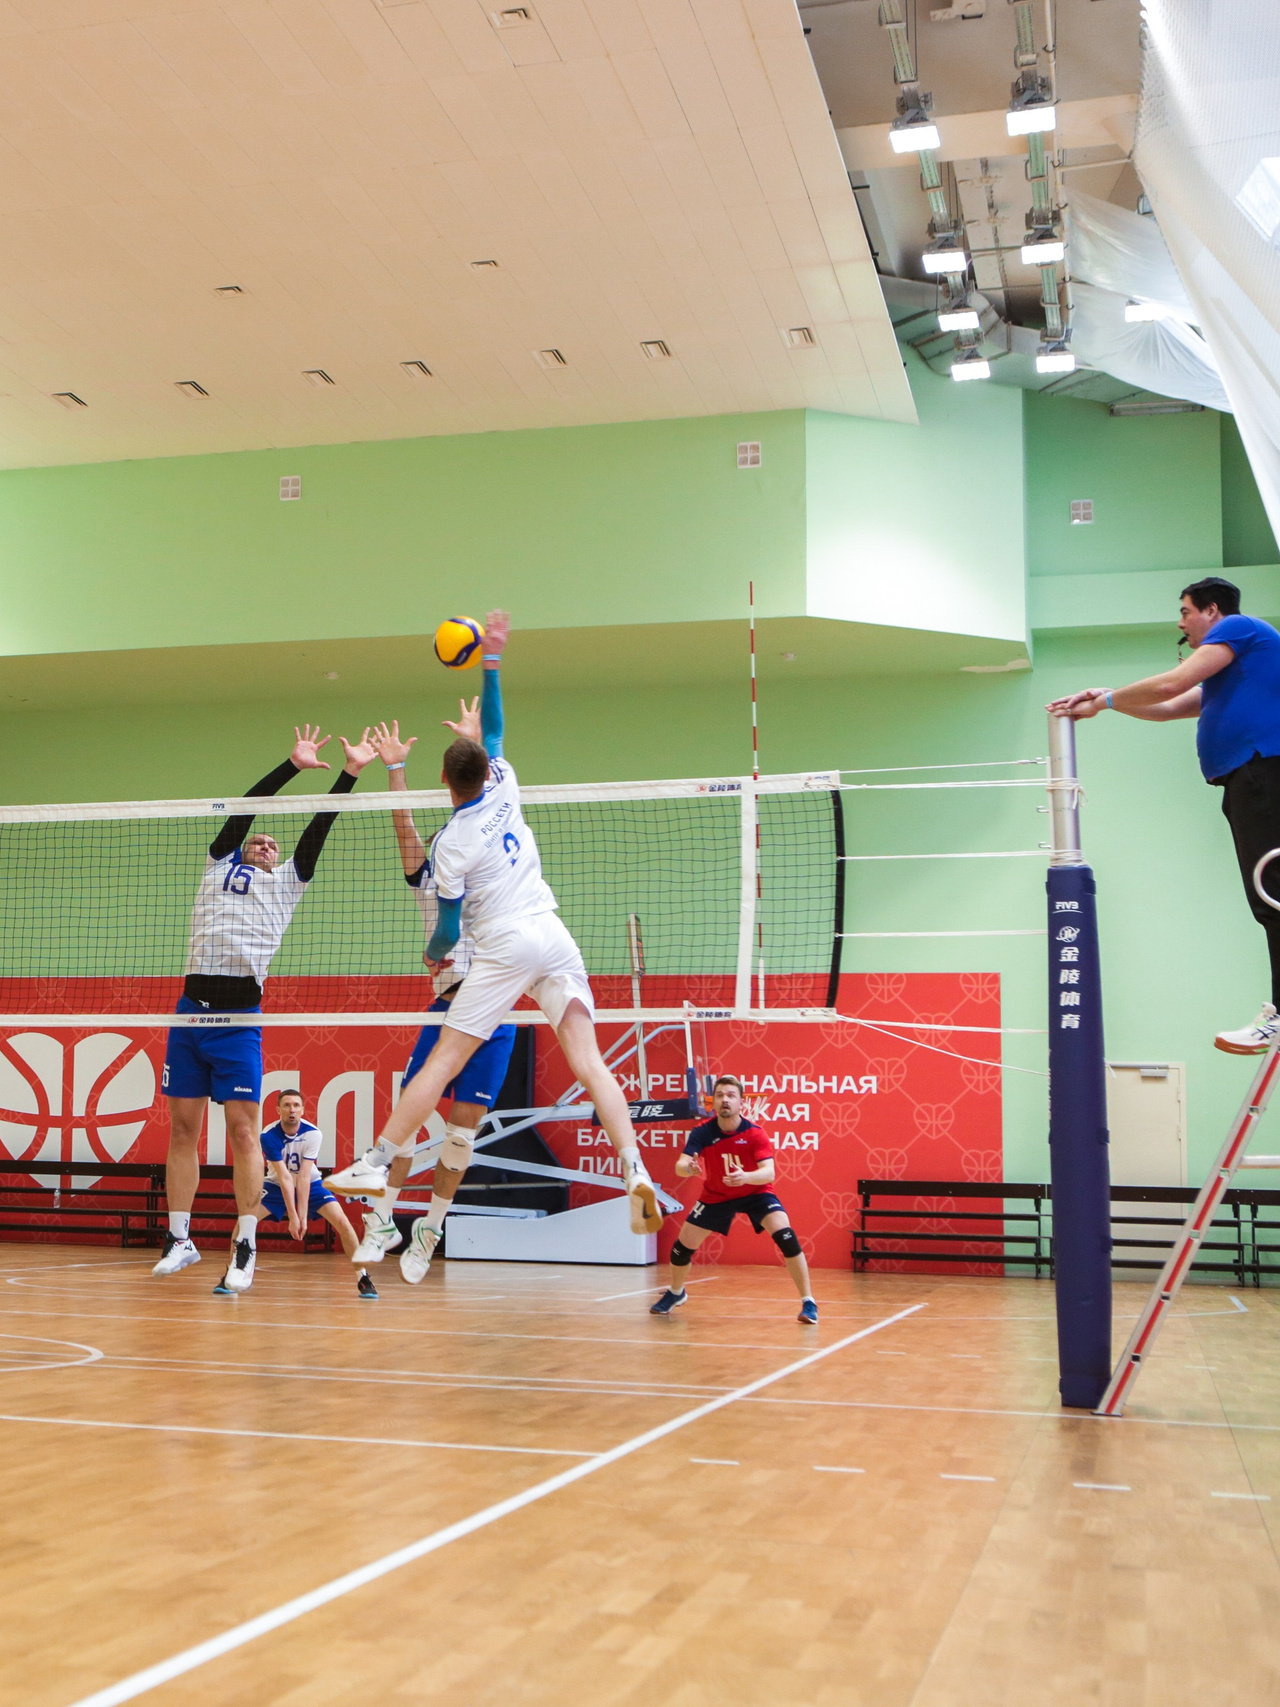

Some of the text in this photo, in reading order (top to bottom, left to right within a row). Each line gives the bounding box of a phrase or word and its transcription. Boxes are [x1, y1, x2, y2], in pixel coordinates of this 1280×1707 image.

[480, 802, 512, 835] РОССЕТИ
[223, 865, 256, 896] 15
[1055, 901, 1080, 910] FIVB
[286, 1152, 301, 1174] 13
